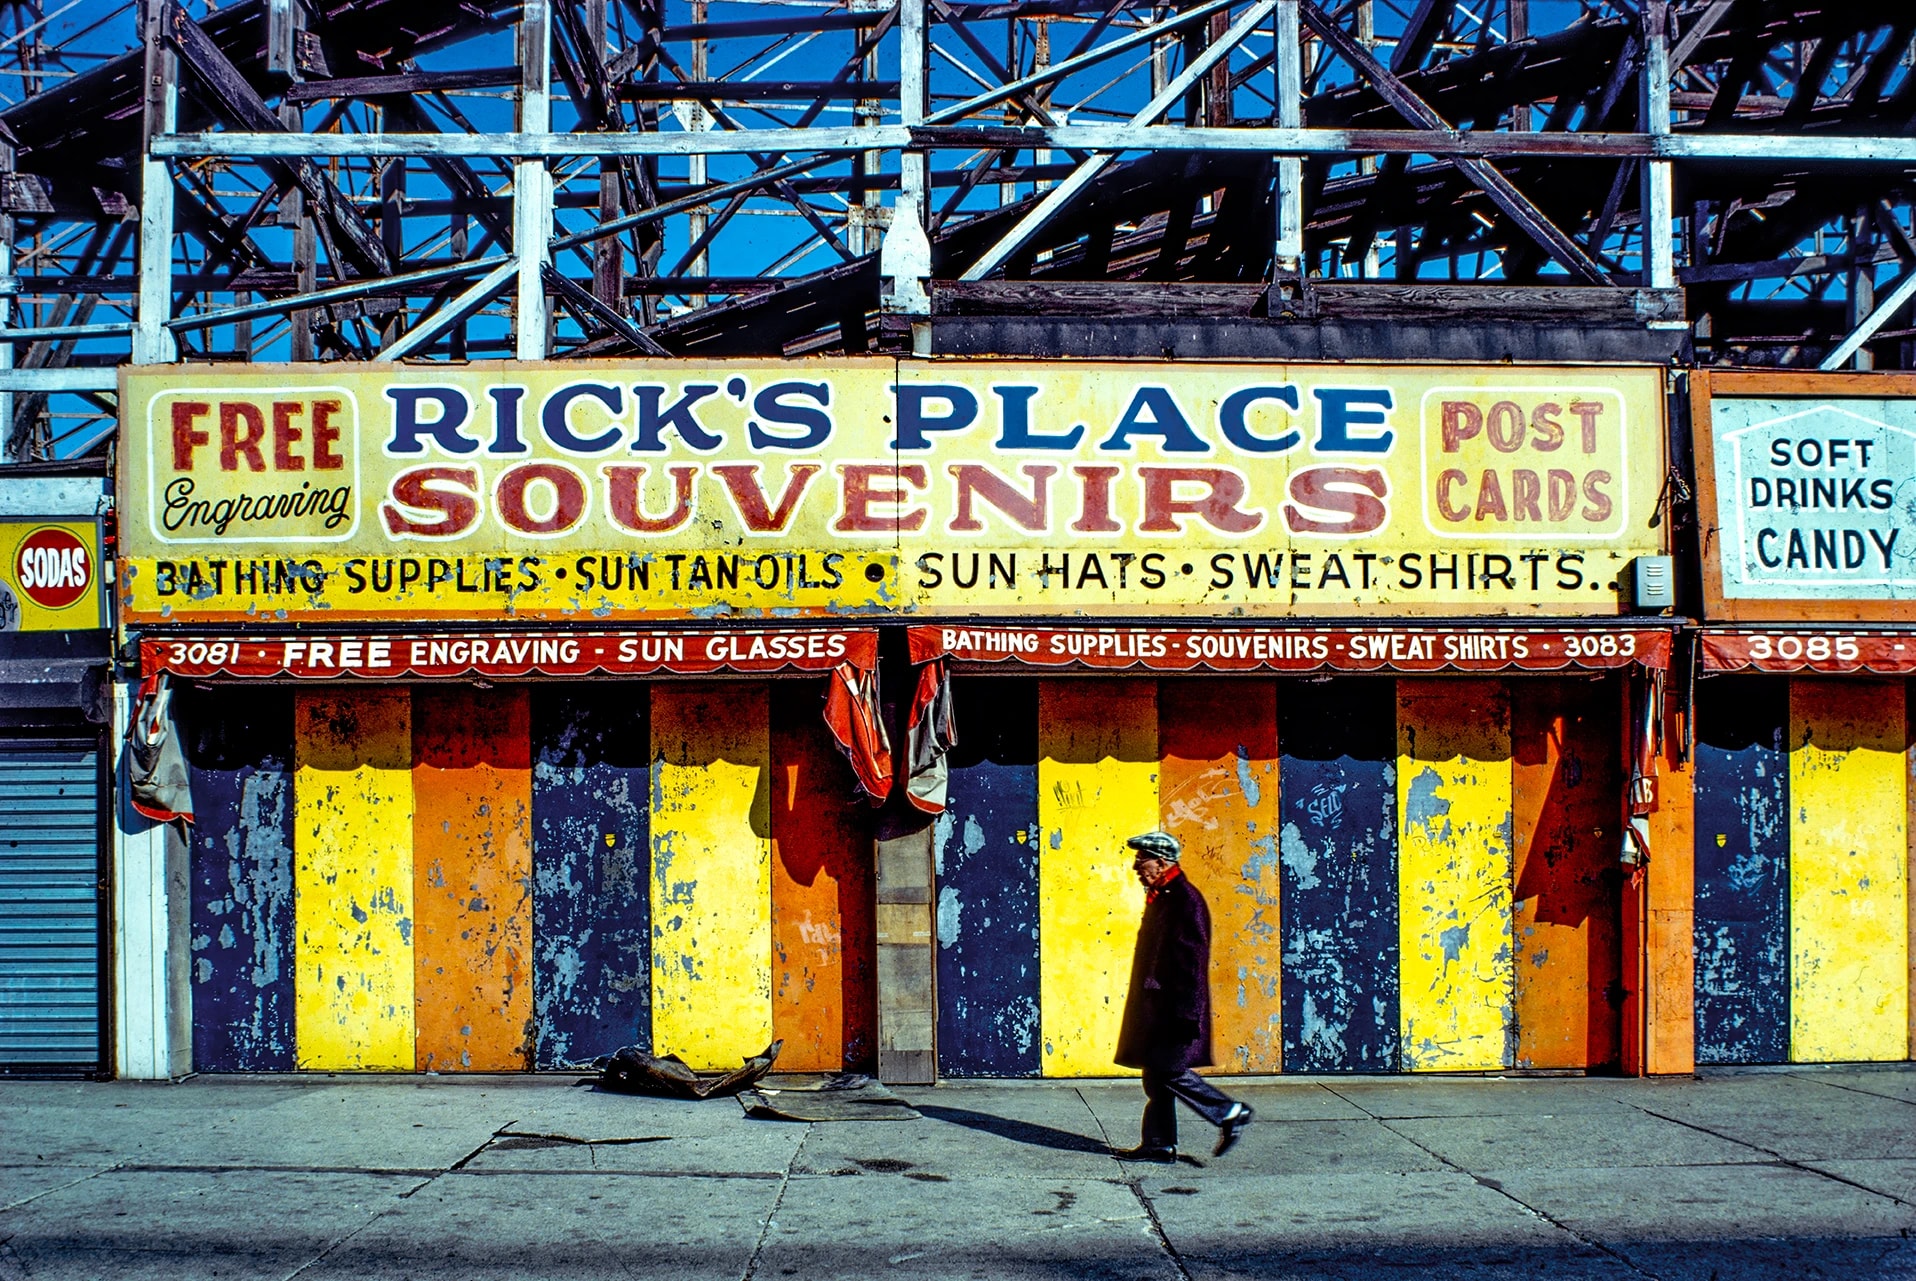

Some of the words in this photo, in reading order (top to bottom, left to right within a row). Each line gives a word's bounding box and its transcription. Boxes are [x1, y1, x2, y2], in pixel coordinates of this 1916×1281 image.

[171, 400, 344, 472] FREE
[386, 377, 833, 454] RICK'S
[889, 384, 1395, 453] PLACE
[1440, 401, 1604, 455] POST
[1770, 438, 1874, 468] SOFT
[163, 477, 351, 535] Engraving
[383, 463, 1388, 536] SOUVENIRS
[1435, 468, 1612, 523] CARDS
[1750, 476, 1894, 510] DRINKS
[20, 547, 87, 589] SODAS
[1756, 527, 1901, 570] CANDY
[156, 558, 330, 597] BATHING
[345, 556, 542, 594] SUPPLIES
[575, 555, 650, 592] SUN
[664, 553, 739, 591] TAN
[754, 553, 845, 590] OILS
[916, 552, 1017, 590] SUN
[1041, 552, 1166, 590] HATS
[1209, 552, 1377, 590] SWEAT
[168, 642, 240, 665] 3081
[283, 641, 392, 668] FREE
[410, 639, 581, 666] ENGRAVING
[617, 637, 684, 663] SUN
[705, 634, 848, 661] GLASSES
[942, 628, 1039, 653] BATHING
[1050, 634, 1168, 658] SUPPLIES
[1186, 635, 1329, 660] SOUVENIRS
[1348, 634, 1437, 660] SWEAT
[1443, 635, 1529, 660] SHIRTS
[1563, 634, 1637, 658] 3083
[1747, 635, 1860, 661] 3085
